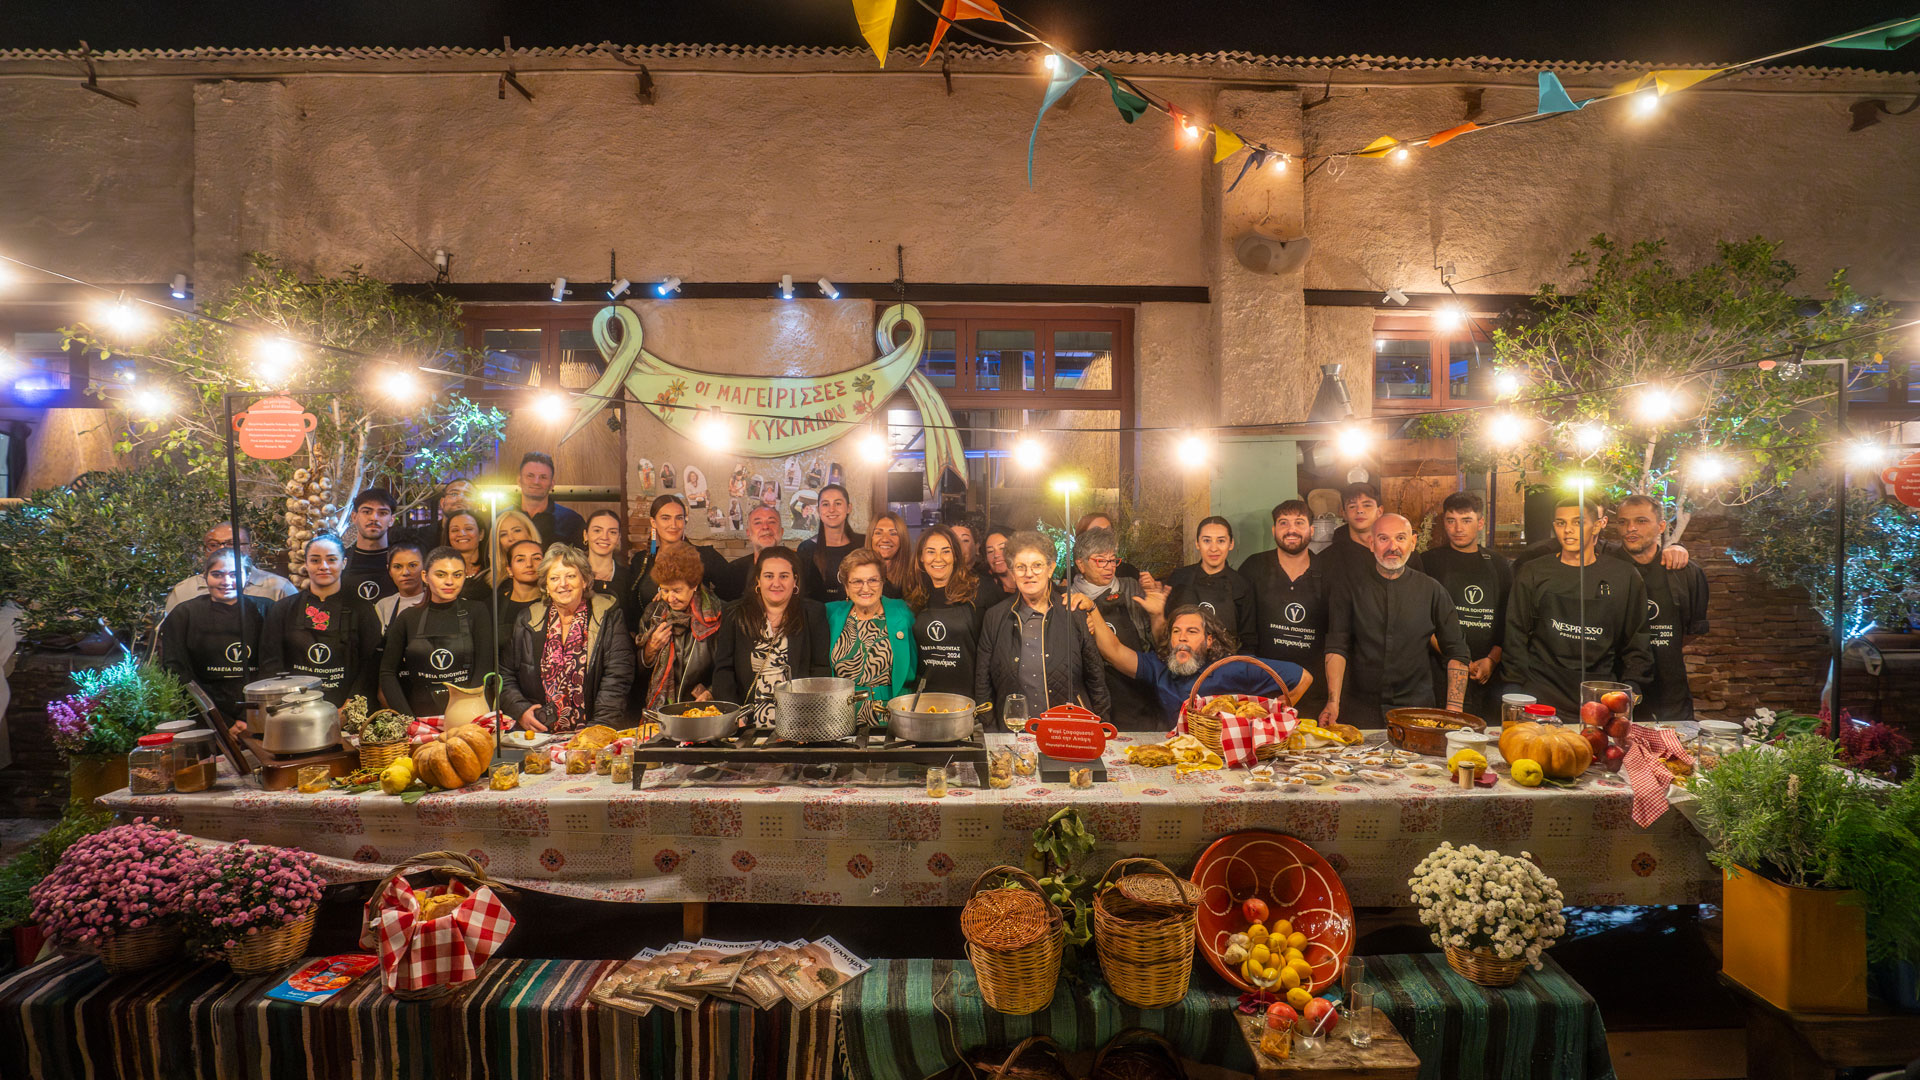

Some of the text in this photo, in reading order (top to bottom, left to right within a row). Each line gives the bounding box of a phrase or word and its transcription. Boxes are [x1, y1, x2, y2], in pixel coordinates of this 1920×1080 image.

[695, 380, 847, 408] ΟΙ ΜΑΓΕΙΡΙΣΣΕΣ
[747, 404, 847, 443] ΚΥΚΛΑΔΩΝ
